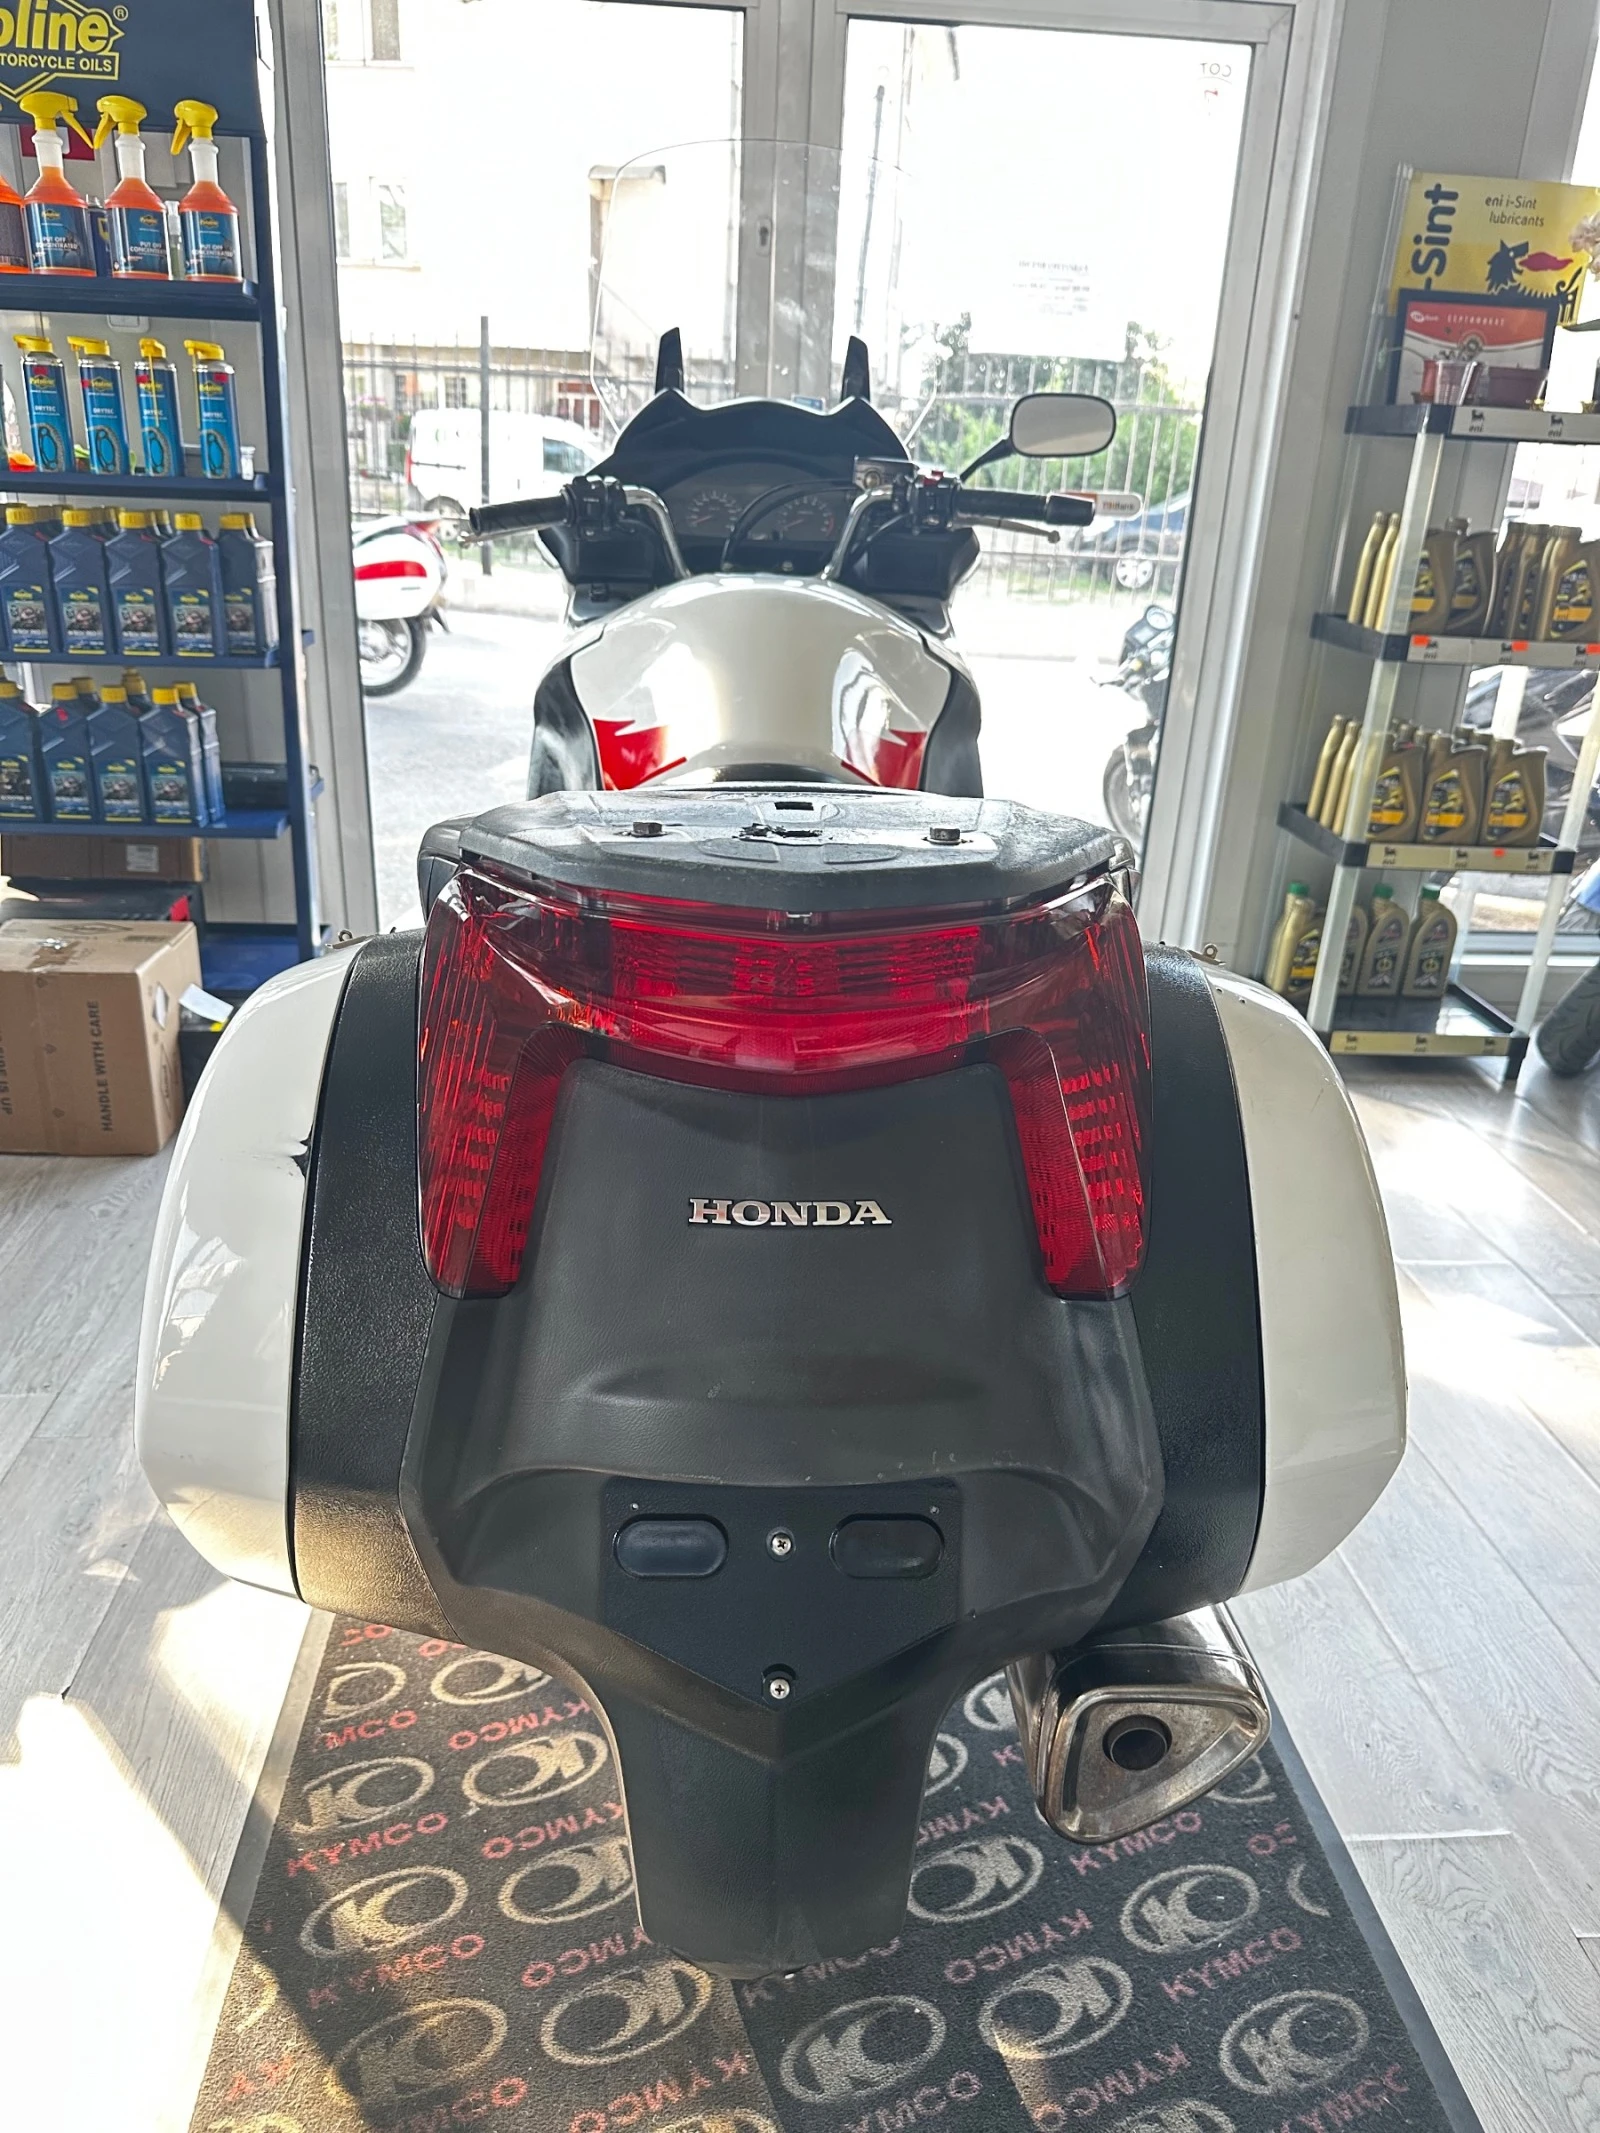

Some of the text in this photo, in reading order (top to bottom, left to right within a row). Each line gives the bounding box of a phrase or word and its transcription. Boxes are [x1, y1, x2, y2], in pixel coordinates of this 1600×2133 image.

[80, 58, 112, 72] OILS
[1485, 194, 1537, 210] eni i-Sint
[1489, 210, 1545, 228] lubricants
[87, 1000, 113, 1132] HANDLE WITH CARE
[689, 1198, 893, 1227] HONDA
[448, 1698, 592, 1750] KYMCO
[287, 1812, 449, 1878] KYMCO
[1069, 1811, 1202, 1876] KYMCO
[944, 1908, 1094, 1984] KYMCO
[1161, 1926, 1302, 2003] KYMCO
[569, 2050, 750, 2133] KYMCO
[1033, 2042, 1192, 2133] KYMCO
